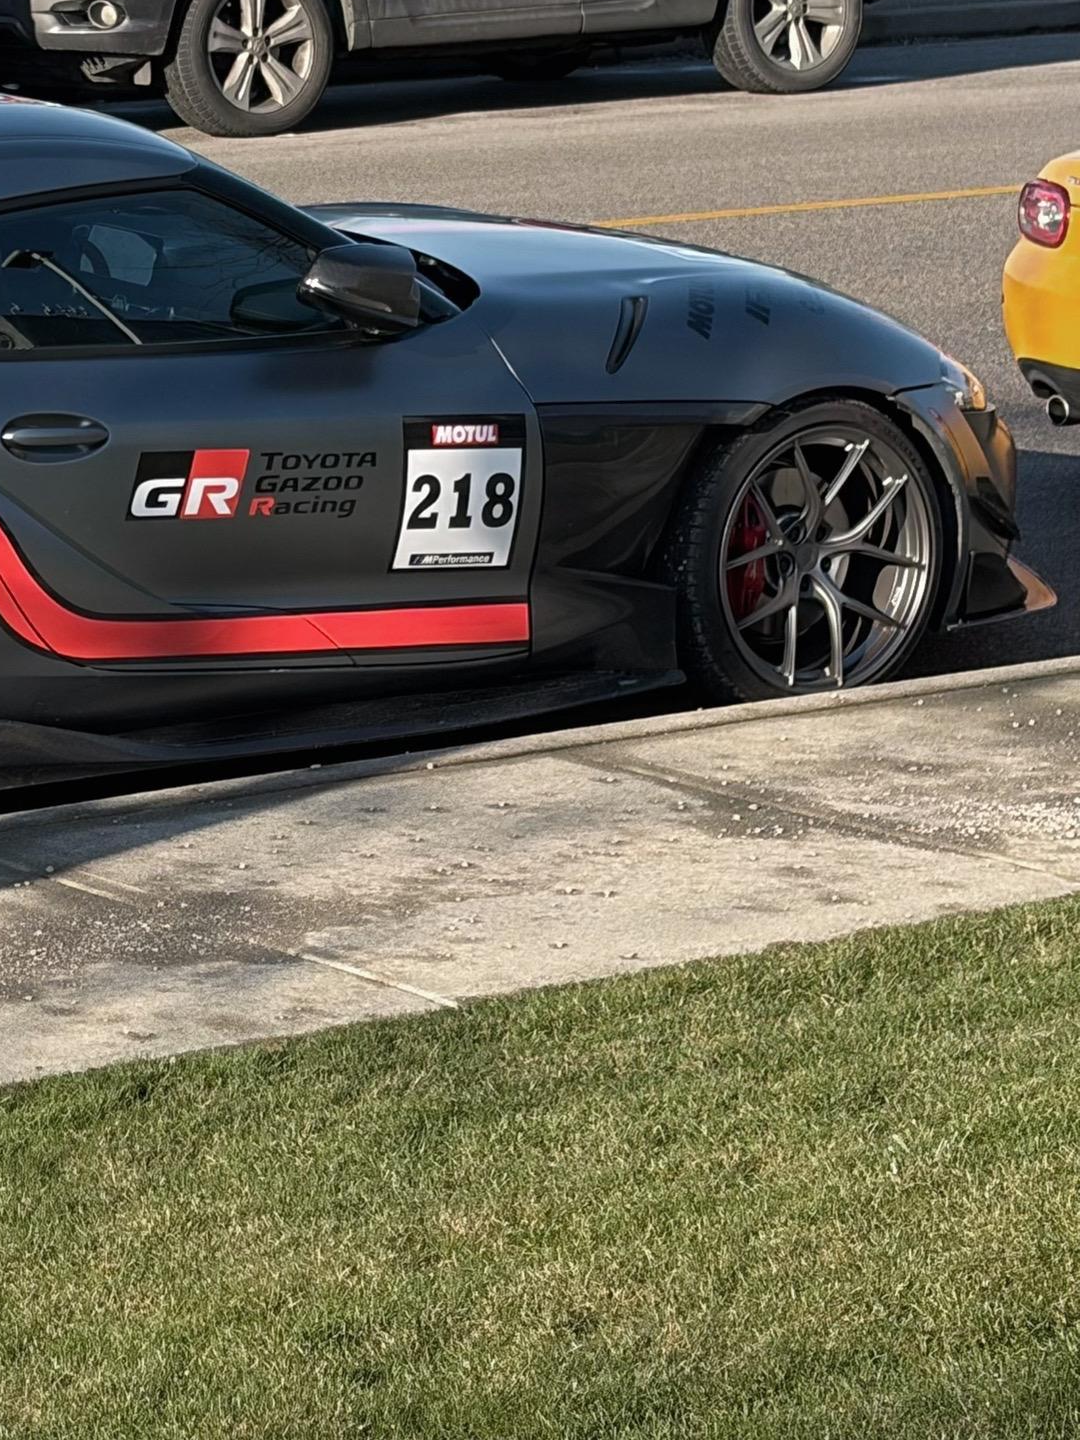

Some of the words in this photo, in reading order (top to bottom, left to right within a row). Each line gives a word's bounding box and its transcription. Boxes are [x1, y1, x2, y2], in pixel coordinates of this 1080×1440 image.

[434, 425, 497, 444] MOTUL
[261, 452, 377, 471] TOYOTA
[255, 475, 364, 493] GAZOO
[131, 477, 239, 517] GR
[249, 496, 357, 518] Racing
[406, 472, 515, 530] 218
